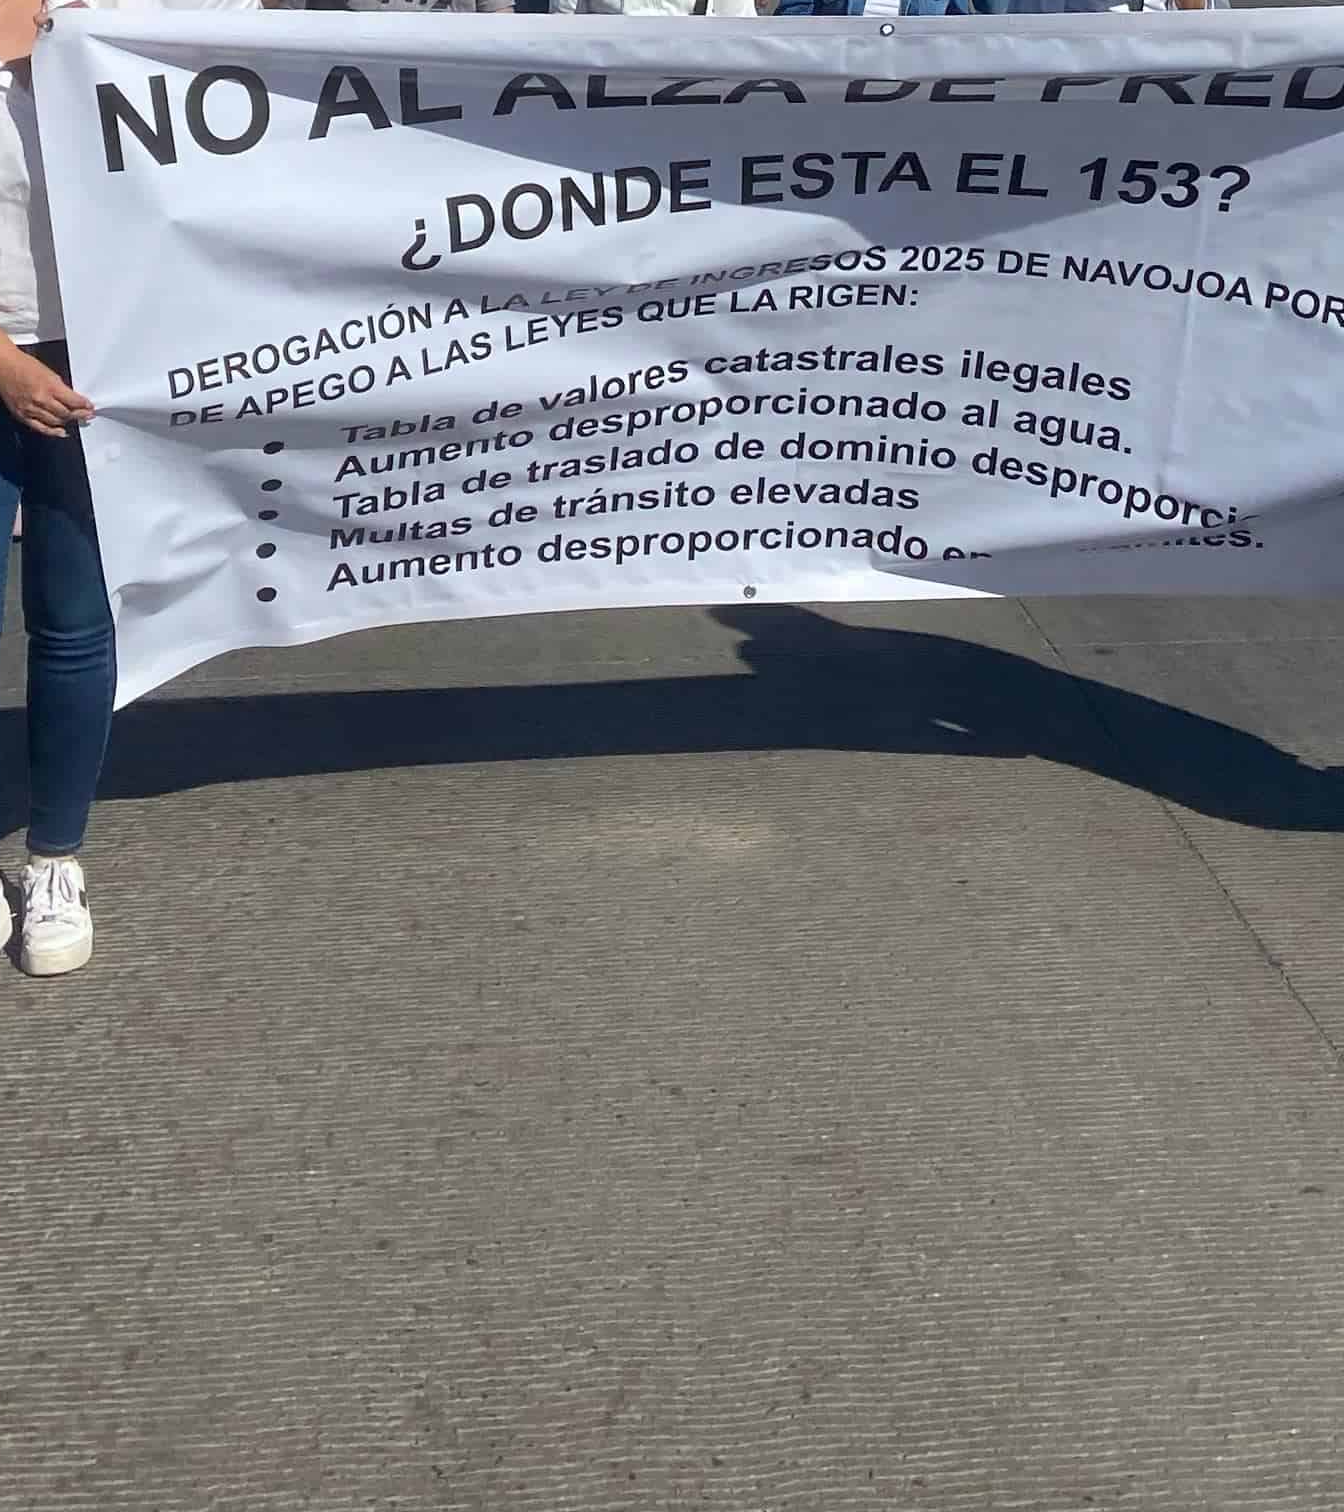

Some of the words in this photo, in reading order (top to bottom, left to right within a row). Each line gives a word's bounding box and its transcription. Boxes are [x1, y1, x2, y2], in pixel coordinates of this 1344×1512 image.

[95, 64, 270, 173] NO
[308, 65, 462, 140] AL
[492, 72, 808, 116] ALZA
[843, 77, 996, 103] DE
[400, 158, 713, 271] ¿DONDE
[739, 151, 931, 204] ESTA
[956, 152, 1049, 198] EL
[1079, 156, 1251, 213] 153?
[168, 302, 433, 399] DEROGACIÓN
[443, 298, 470, 324] A
[479, 293, 531, 316] LA
[540, 284, 625, 306] LEY
[690, 245, 887, 286] INGRESOS
[899, 246, 985, 272] 2025
[997, 248, 1050, 279] DE
[1062, 255, 1254, 306] NAVOJOA
[169, 404, 224, 427] DE
[236, 364, 374, 419] APEGO
[386, 355, 412, 386] A
[421, 330, 493, 377] LAS
[504, 305, 624, 353] LEYES
[636, 294, 717, 323] QUE
[729, 288, 778, 313] LA
[789, 284, 919, 311] RIGEN:
[334, 426, 534, 482] Aumento
[549, 387, 947, 443] desproporcionado
[961, 399, 998, 429] al
[1013, 409, 1132, 455] agua.
[339, 414, 456, 445] Tabla
[472, 399, 523, 426] de
[538, 358, 689, 412] valores
[703, 345, 945, 377] catastrales
[960, 349, 1132, 401] ilegales
[329, 516, 472, 550] Multas
[489, 500, 538, 524] de
[552, 480, 716, 518] tránsito
[730, 477, 920, 510] elevadas
[333, 482, 446, 519] Tabla
[461, 469, 512, 495] de
[526, 440, 699, 483] traslado
[714, 432, 764, 461] de
[780, 432, 957, 470] dominio
[972, 447, 1266, 529] desproporci
[326, 545, 523, 592] Aumento
[537, 520, 929, 565] desproporcionado
